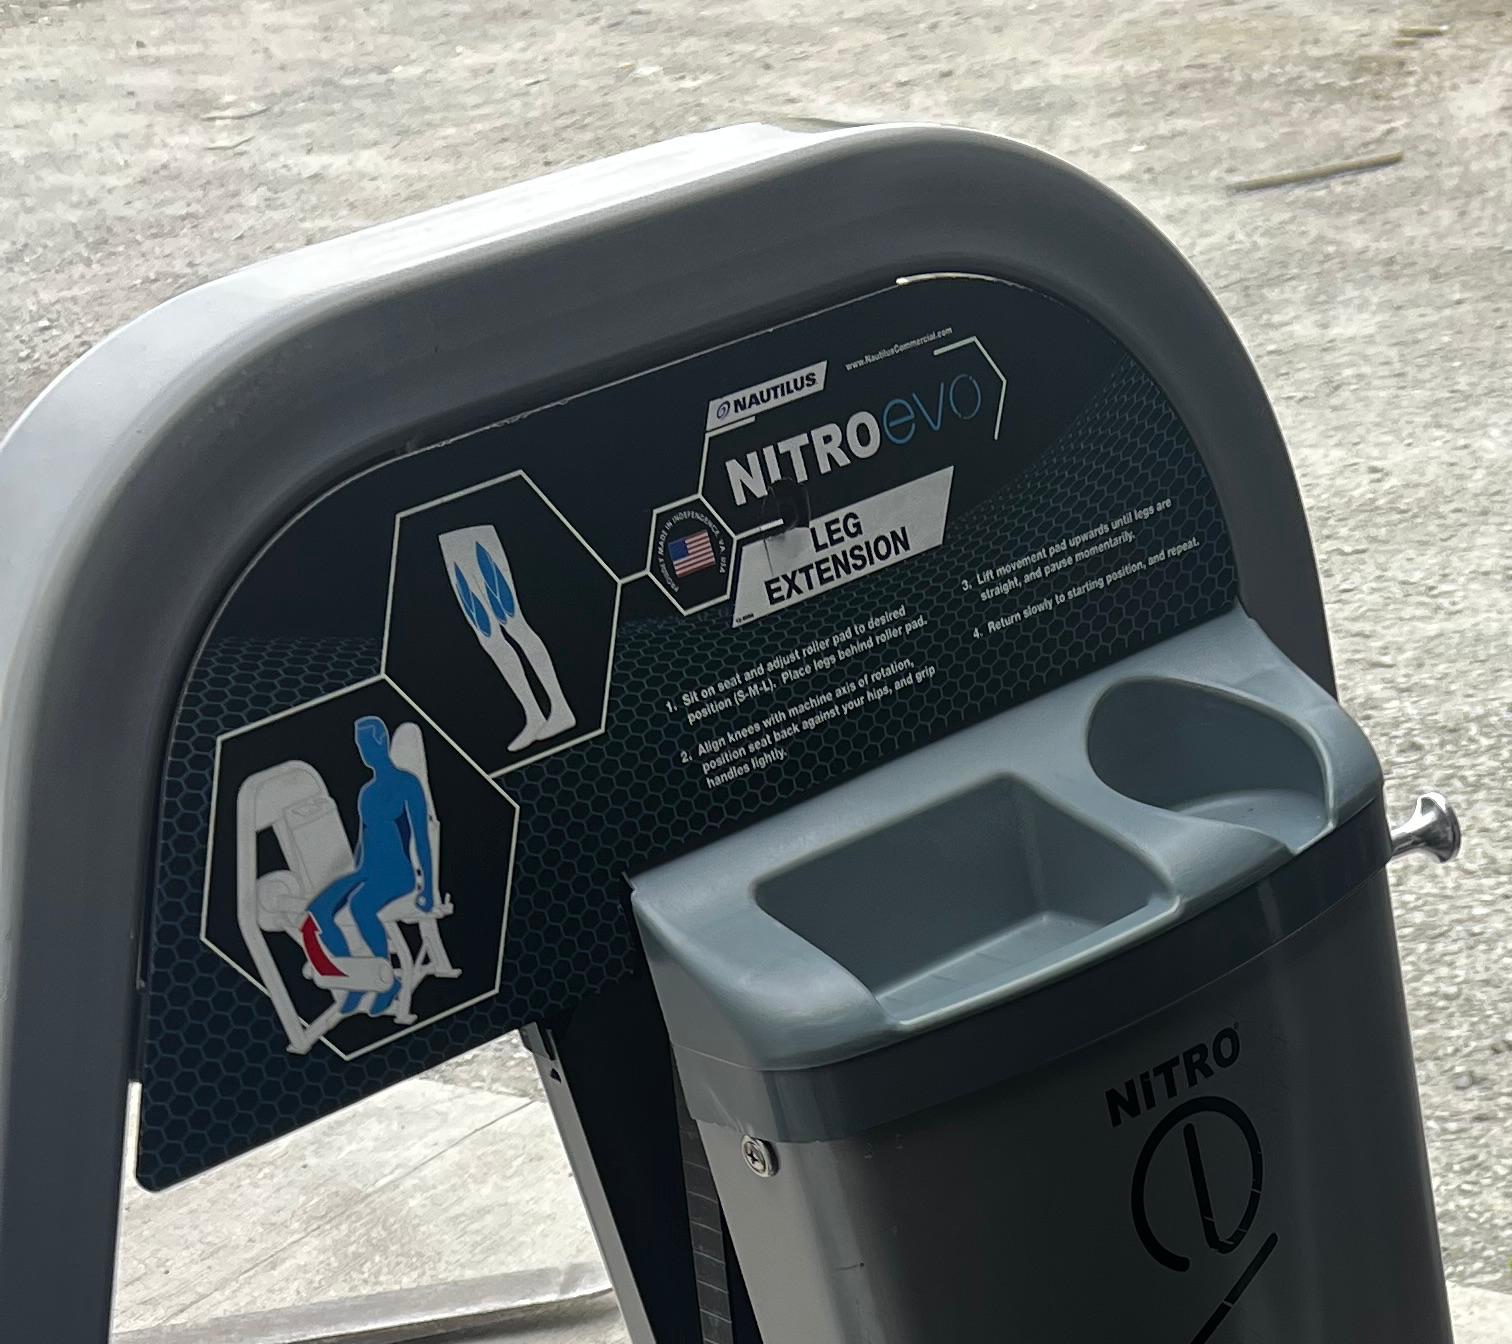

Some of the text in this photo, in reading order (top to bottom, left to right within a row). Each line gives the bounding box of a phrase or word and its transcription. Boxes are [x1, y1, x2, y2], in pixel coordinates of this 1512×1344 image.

[733, 372, 817, 413] NAUTILUS
[845, 327, 953, 371] www.NautilusCommercial.com
[764, 526, 911, 606] EXTENSION
[811, 512, 863, 553] LEG
[962, 498, 1171, 590] 3. Lift movement pad upwards until legs are
[981, 531, 1135, 600] straight, and pause momentarily.
[973, 537, 1199, 638] 4. Return slowly to starting position, and repeat.
[666, 604, 905, 712] 1. Sit on seat and adjust roller pad to desired
[687, 615, 927, 725] position (S-M-L). Place legs behind roller pad.
[681, 658, 914, 762] 2. Align knees with machine axis of rotation,
[702, 666, 935, 774] position seat back against your hips, and grip
[706, 748, 786, 788] handles lightly.
[1104, 1026, 1241, 1128] NITRO
